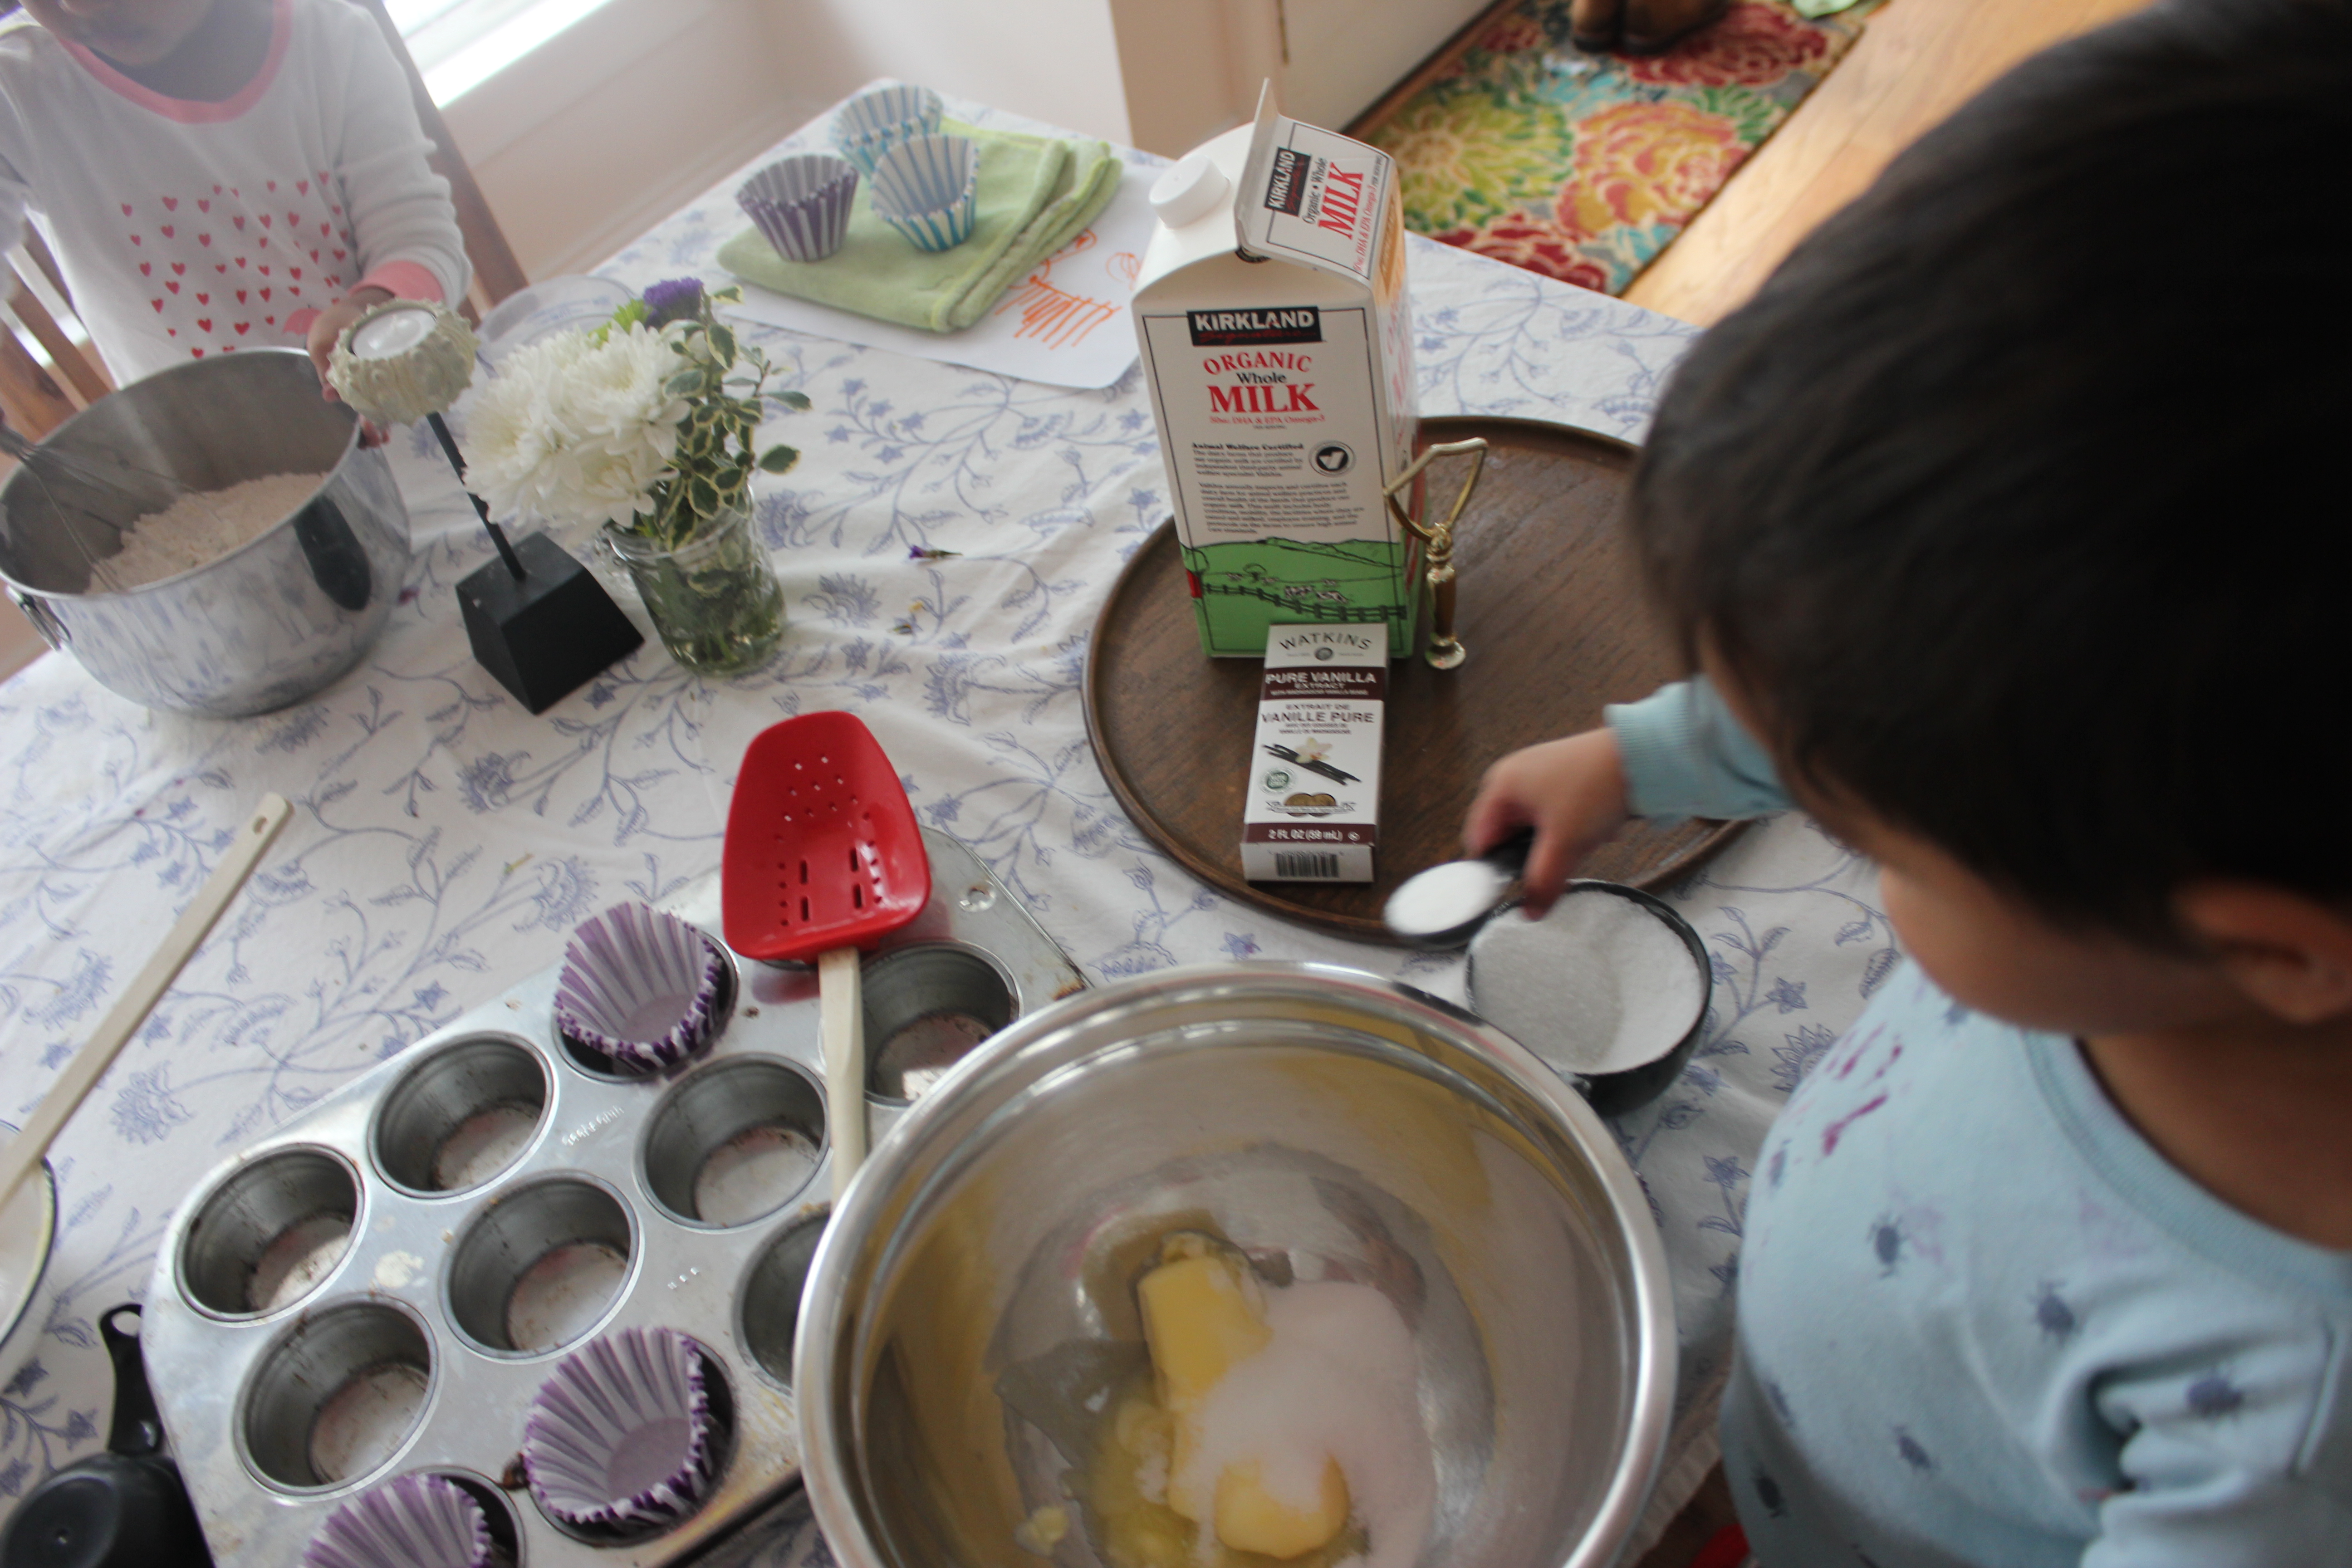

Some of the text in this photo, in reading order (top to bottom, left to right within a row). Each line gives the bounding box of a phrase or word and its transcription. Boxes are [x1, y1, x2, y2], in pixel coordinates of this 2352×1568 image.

[1268, 150, 1295, 210] KIRKLAND
[1302, 157, 1328, 224] Organic Whole
[1318, 162, 1363, 240] MILK
[1195, 311, 1315, 332] KIRKLAND
[1203, 351, 1312, 375] ORGANIC
[1236, 372, 1287, 384] Whole
[1206, 383, 1320, 413] MILK
[1279, 632, 1372, 650] WATKINS
[1265, 671, 1377, 684] PURE VANILLA
[1261, 712, 1375, 723] VANILLE PURE
[1268, 829, 1277, 839] 2
